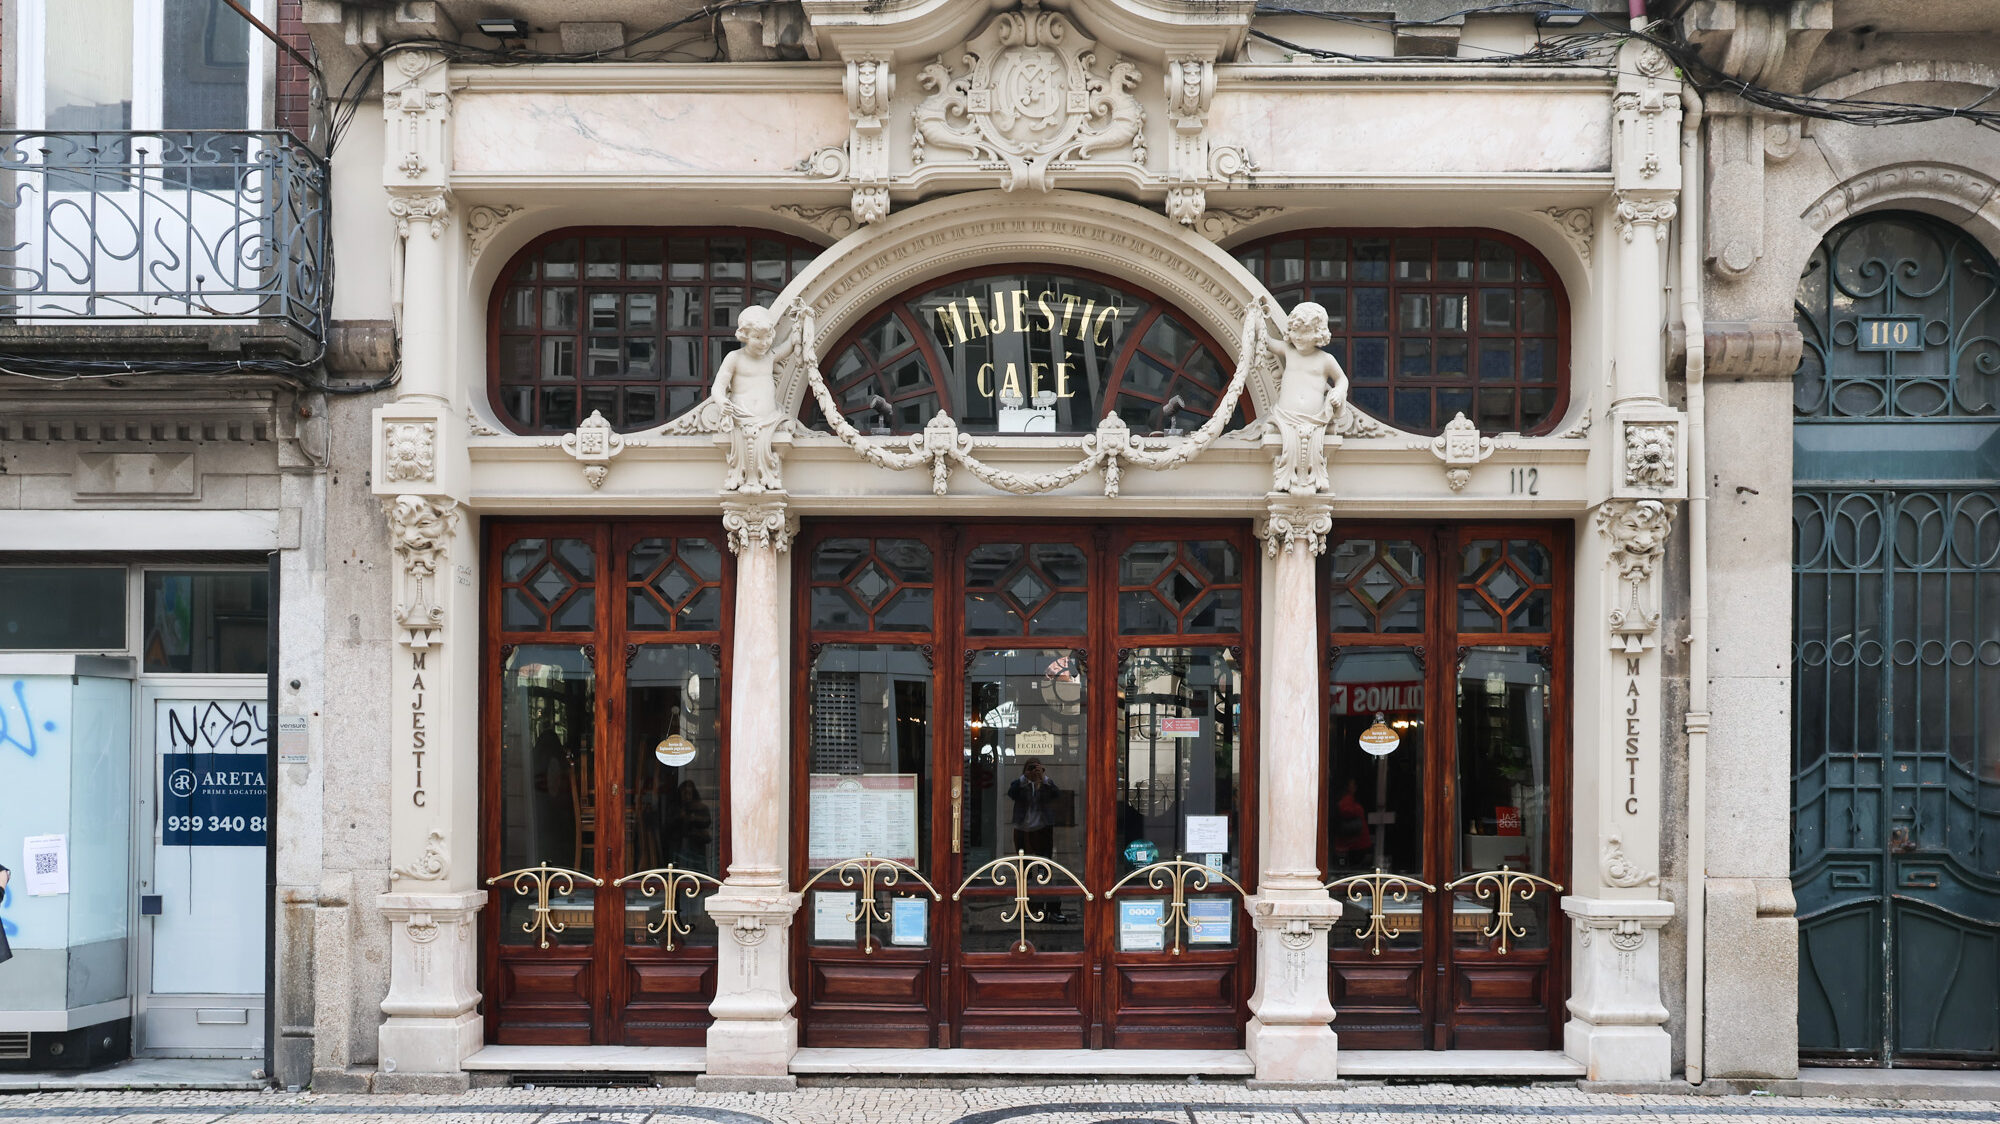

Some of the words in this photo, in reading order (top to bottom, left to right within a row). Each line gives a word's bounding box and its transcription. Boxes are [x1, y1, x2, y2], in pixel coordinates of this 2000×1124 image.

[936, 290, 1120, 347] MAJESTIC
[1871, 322, 1908, 344] 110
[977, 351, 1076, 398] CAFÉ
[1510, 467, 1539, 496] 112
[411, 652, 426, 808] MAJESTIC
[1625, 657, 1641, 815] MAJESTIC
[202, 772, 266, 786] ARETA
[168, 815, 203, 832] 939
[208, 815, 245, 832] 340
